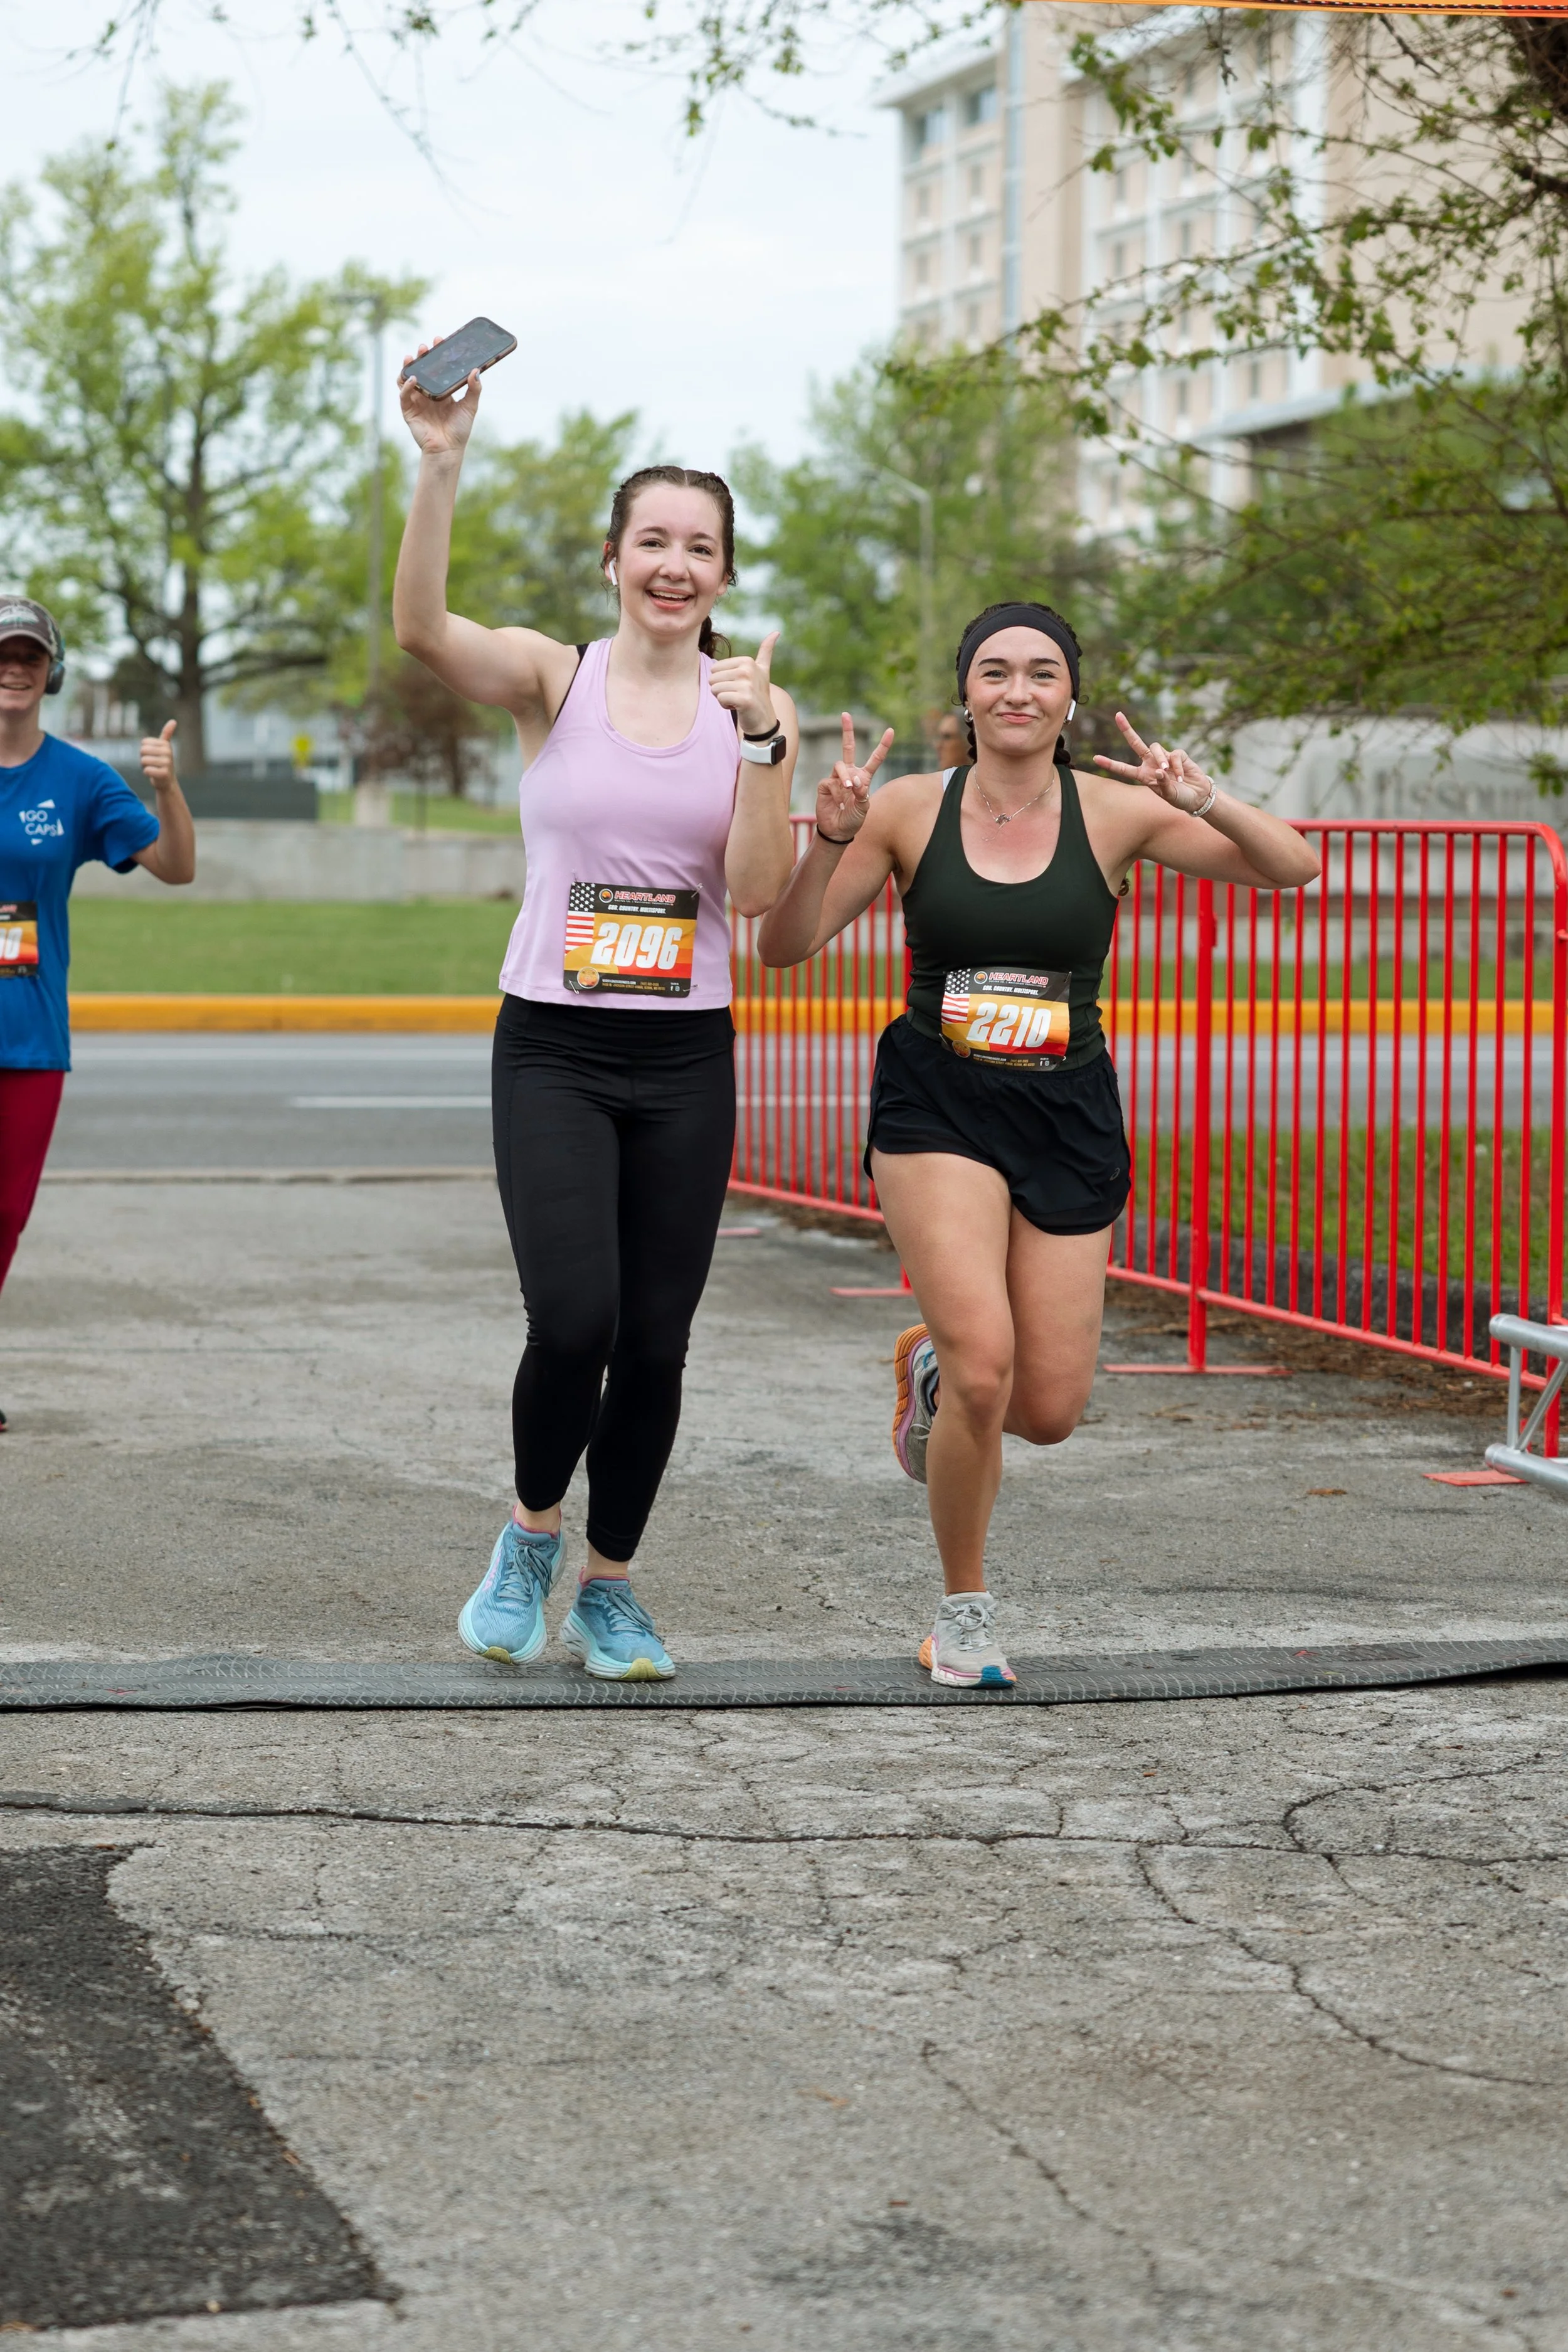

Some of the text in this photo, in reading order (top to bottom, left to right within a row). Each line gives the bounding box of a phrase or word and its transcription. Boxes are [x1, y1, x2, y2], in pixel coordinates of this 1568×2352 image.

[25, 810, 48, 822] GO
[25, 823, 57, 837] CAPS
[614, 891, 675, 903] HEARTLAND
[590, 922, 682, 970] 2096
[988, 972, 1049, 985] HEARTLAND
[967, 1002, 1051, 1047] 2210
